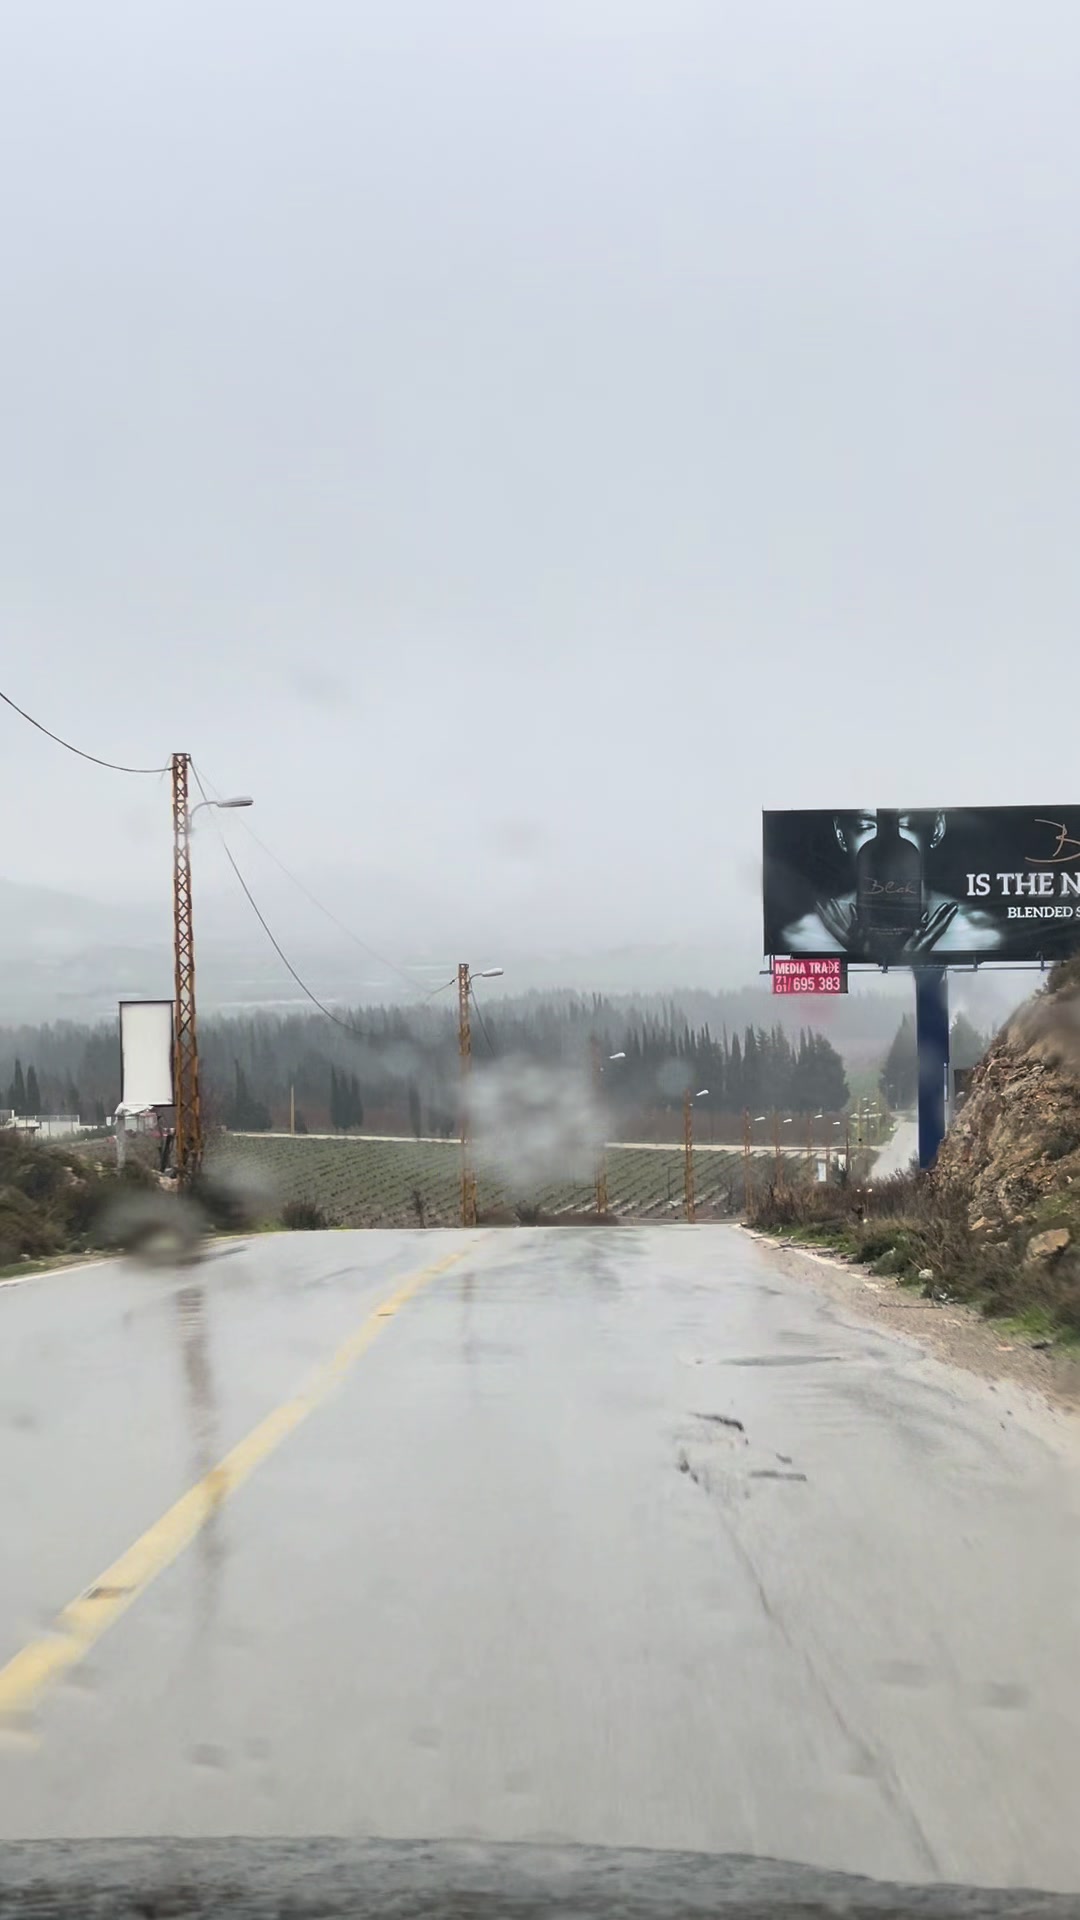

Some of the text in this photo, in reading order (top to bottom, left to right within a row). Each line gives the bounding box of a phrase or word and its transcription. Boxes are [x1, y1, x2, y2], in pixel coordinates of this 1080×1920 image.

[966, 873, 991, 896] IS
[996, 872, 1054, 896] THE
[1007, 906, 1074, 919] BLENDED
[775, 960, 840, 975] MEDIA TRADE
[793, 976, 815, 991] 695
[818, 976, 840, 991] 383
